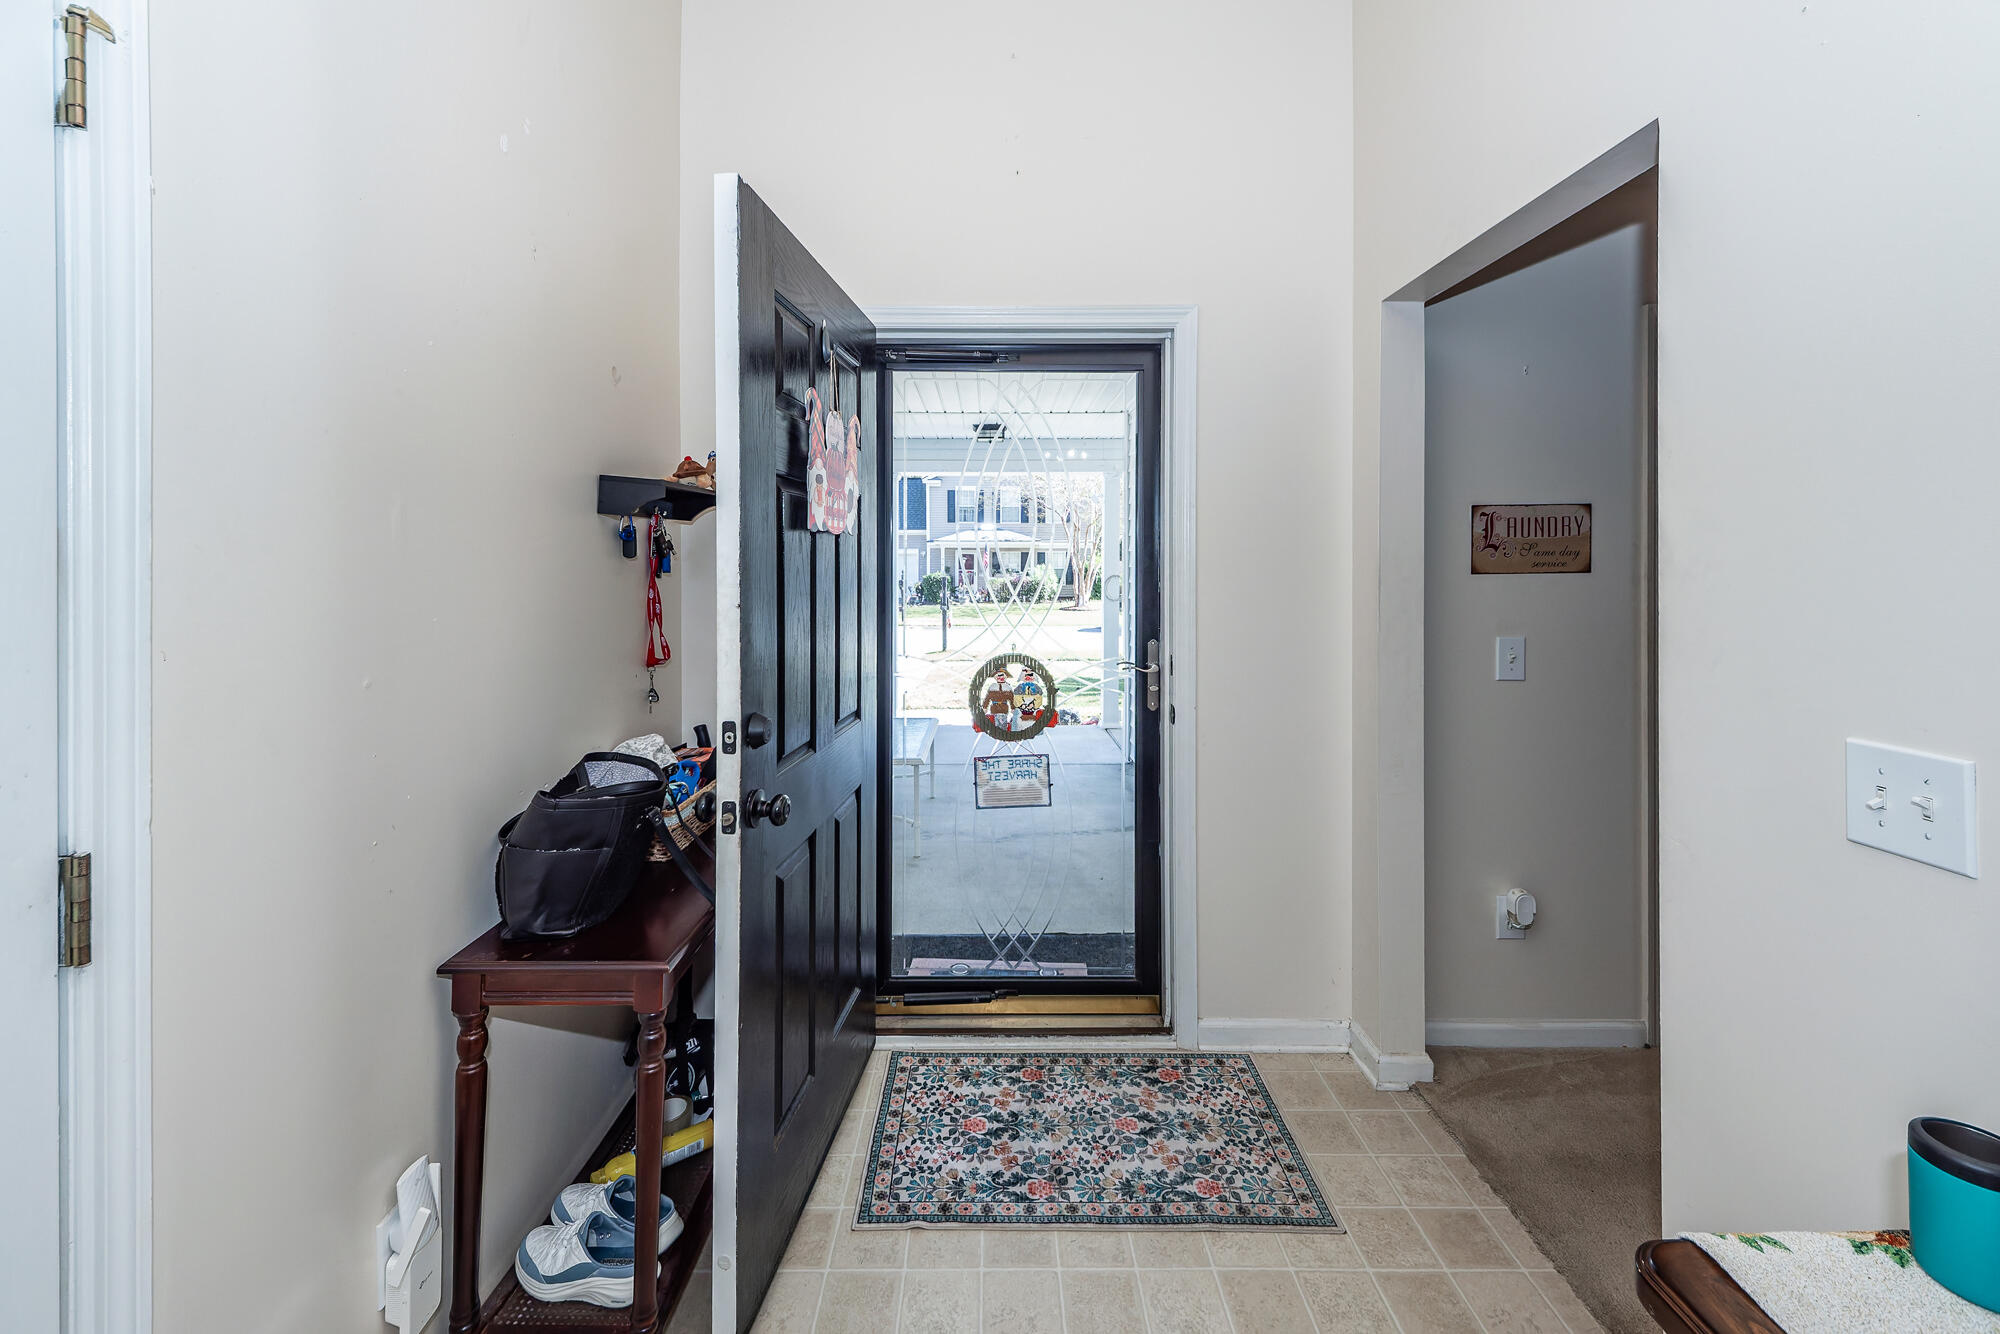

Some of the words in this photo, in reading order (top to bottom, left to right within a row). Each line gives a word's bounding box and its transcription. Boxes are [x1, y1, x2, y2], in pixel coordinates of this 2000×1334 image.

[1479, 511, 1584, 553] LAUNDRY
[1519, 542, 1556, 558] Same
[1559, 545, 1581, 561] day
[1531, 559, 1568, 569] service
